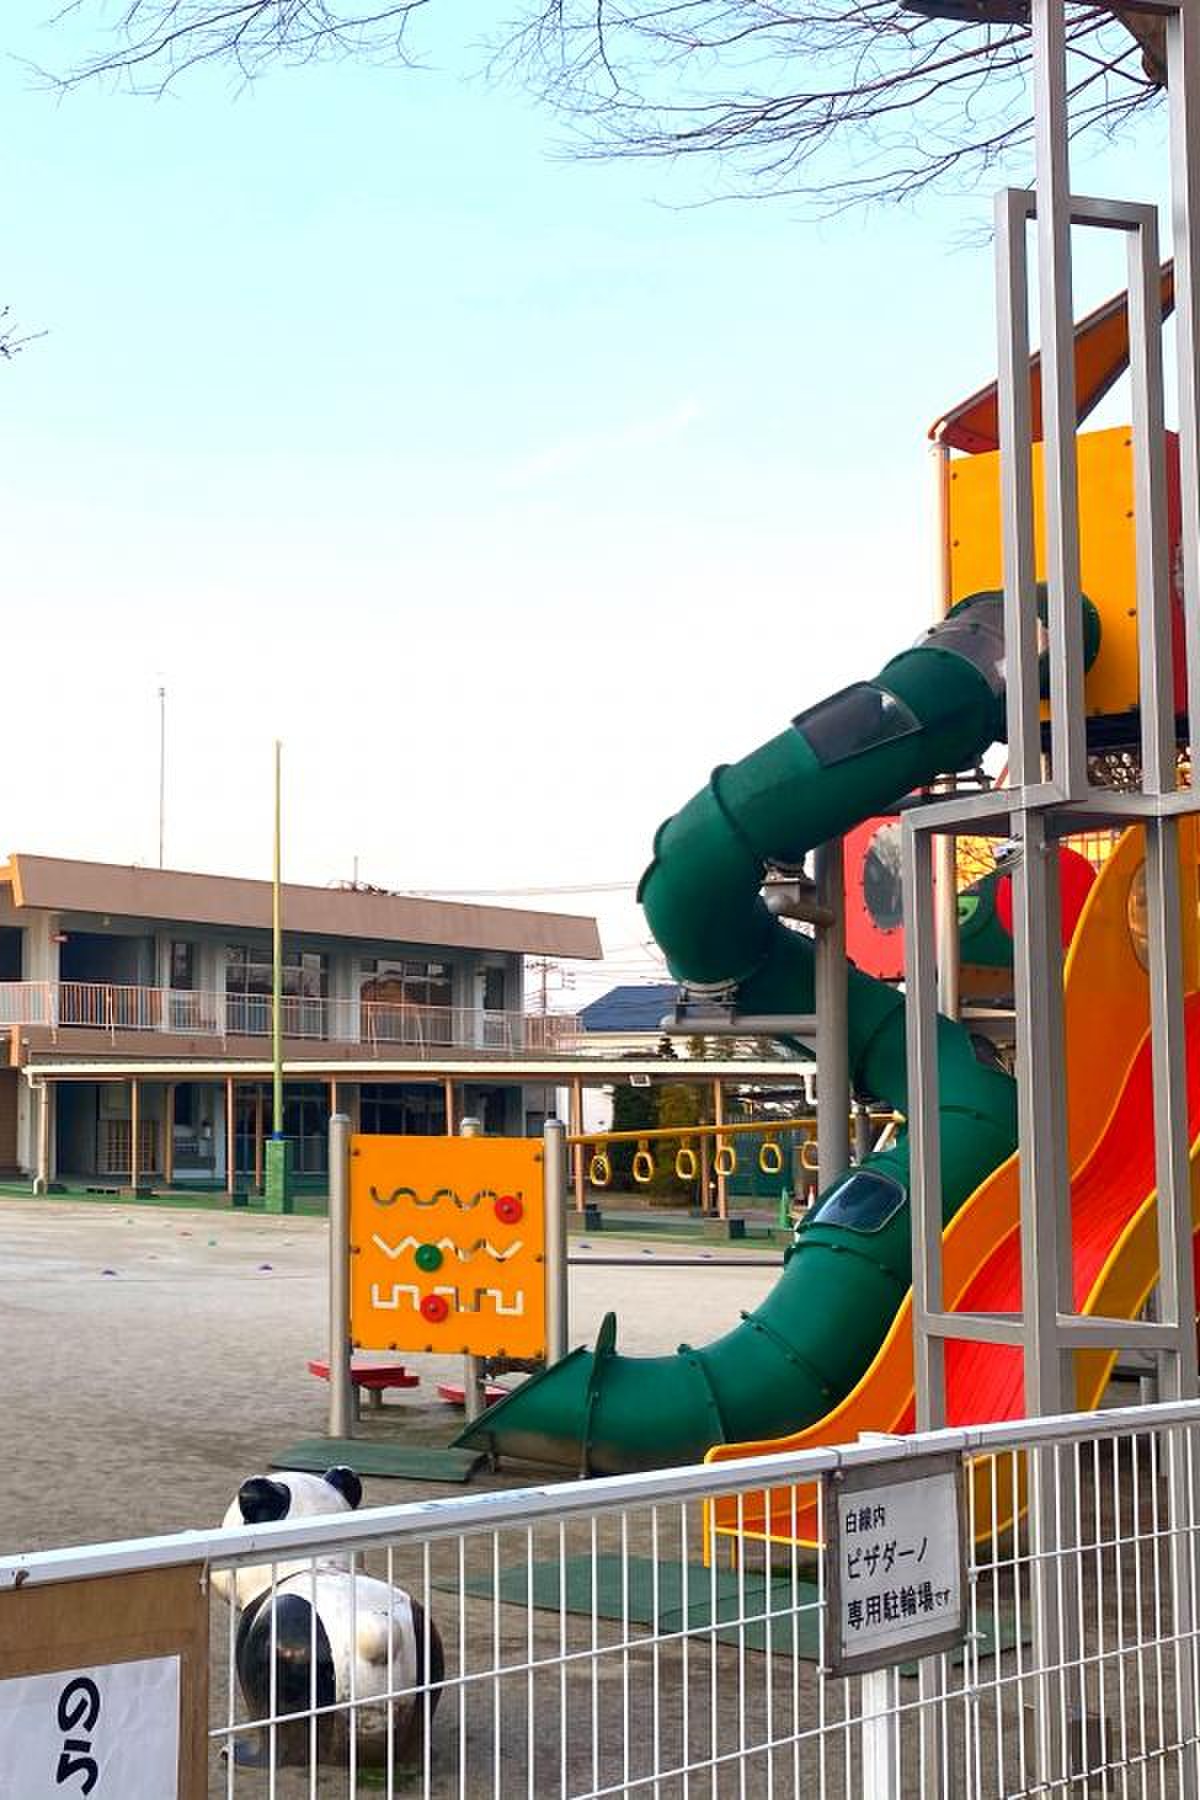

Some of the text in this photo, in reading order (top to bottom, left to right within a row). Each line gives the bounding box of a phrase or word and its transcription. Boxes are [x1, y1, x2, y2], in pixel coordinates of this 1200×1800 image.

[846, 1504, 885, 1533] 白線内
[847, 1537, 927, 1579] ピザダーノ
[848, 1582, 950, 1630] 専用駐輪場です
